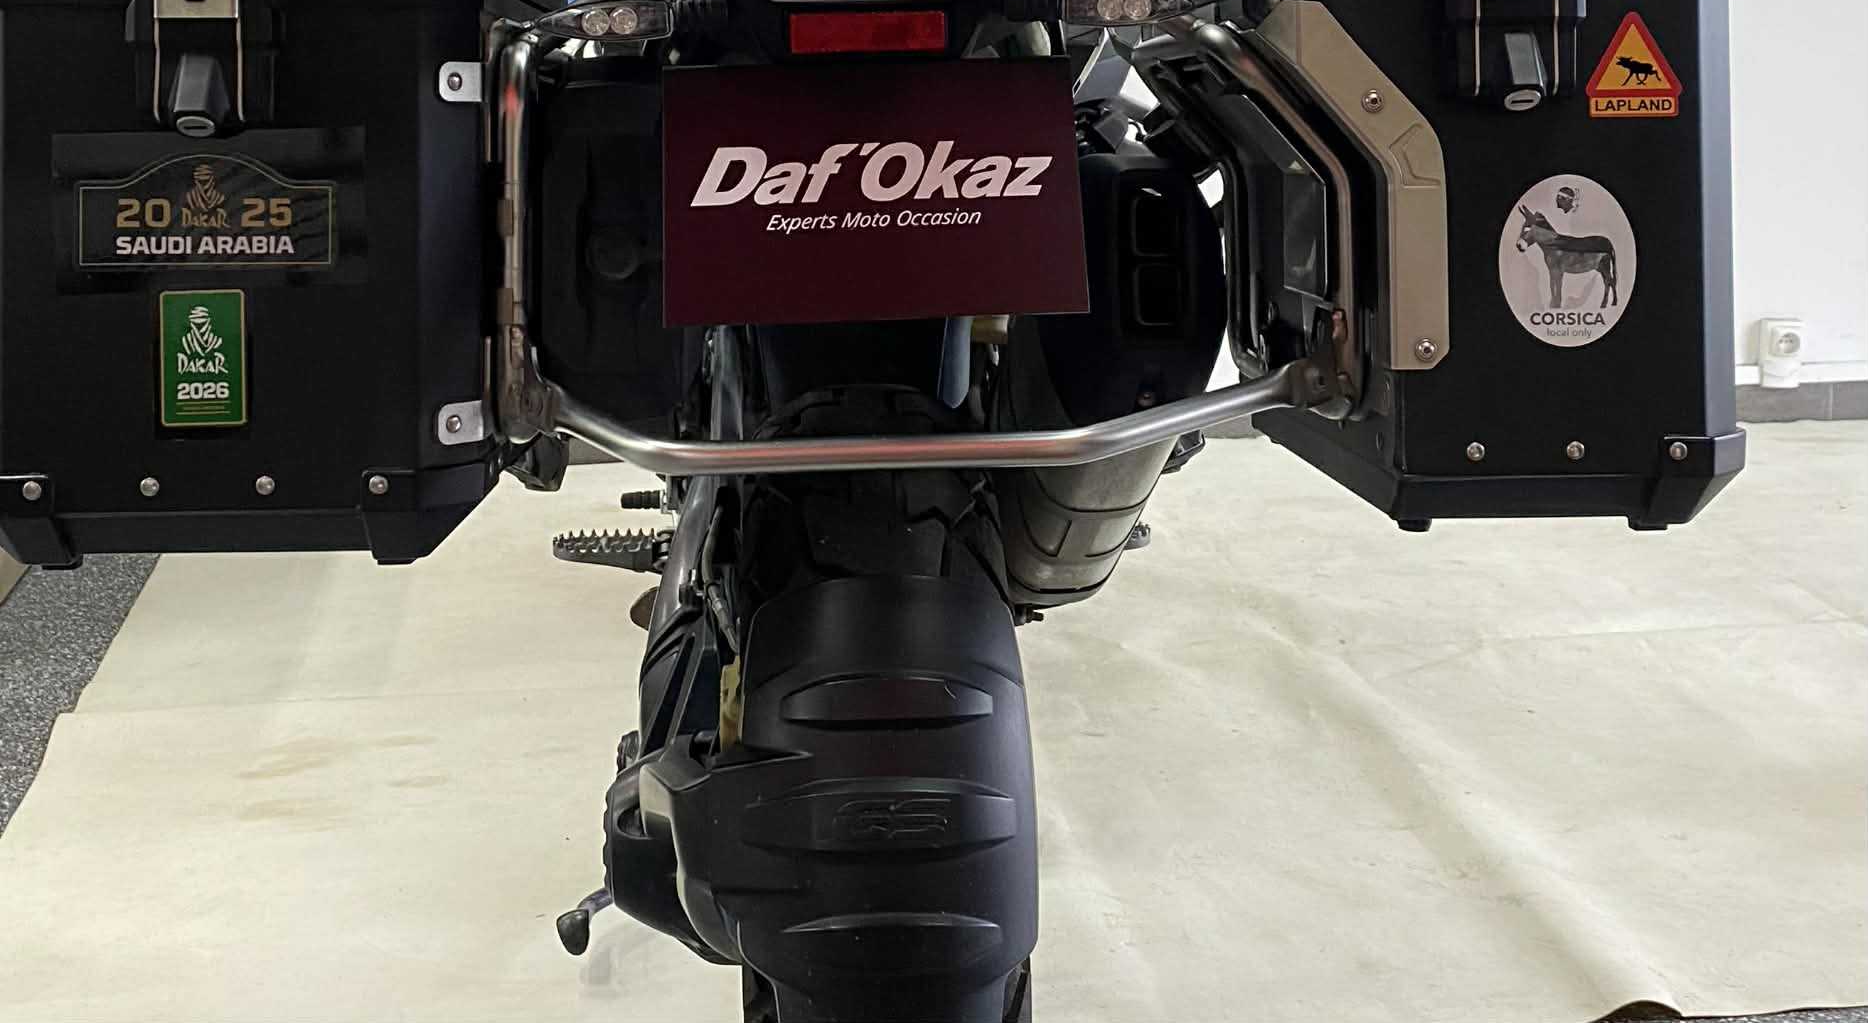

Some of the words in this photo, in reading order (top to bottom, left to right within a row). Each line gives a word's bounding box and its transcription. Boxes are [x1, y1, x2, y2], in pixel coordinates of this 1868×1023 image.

[1595, 99, 1673, 112] LAPLAND
[116, 197, 171, 228] 20
[240, 197, 293, 228] 25
[766, 212, 838, 236] Experts
[841, 211, 891, 229] Moto
[896, 208, 982, 227] Occasion
[115, 235, 191, 255] SAUDI
[197, 235, 294, 254] ARABIA
[1529, 312, 1606, 326] CORSICA
[1546, 327, 1570, 337] local
[1572, 327, 1592, 339] only
[177, 381, 230, 400] 2026
